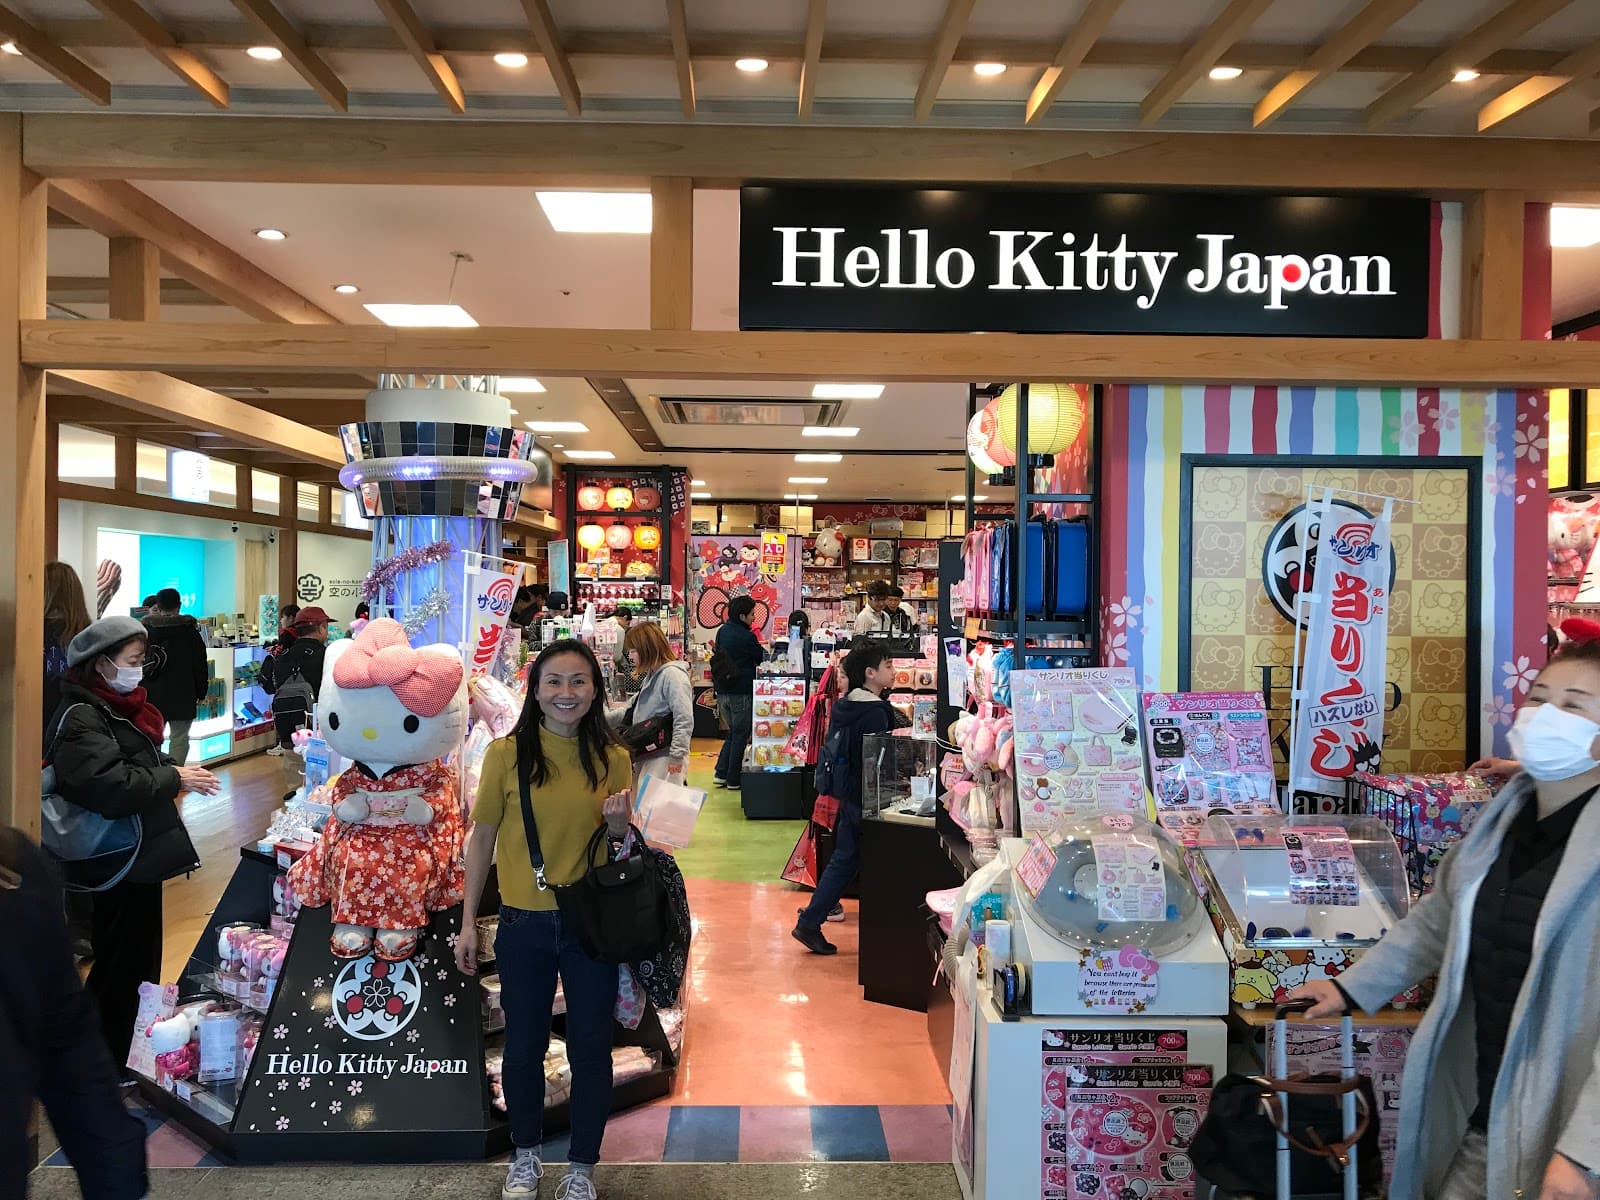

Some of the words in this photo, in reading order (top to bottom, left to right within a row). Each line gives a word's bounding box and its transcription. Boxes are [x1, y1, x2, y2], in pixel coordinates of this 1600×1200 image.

[772, 227, 975, 289] Hello
[989, 230, 1178, 309] Kitty
[1186, 233, 1396, 310] Japan
[765, 544, 783, 553] 入口
[1040, 671, 1108, 681] サンリオ当りくじ
[1177, 699, 1257, 709] サンリオ当りくじ
[1314, 700, 1374, 724] ハズレなし
[1087, 968, 1101, 977] You
[1070, 1032, 1156, 1043] サンリオ当りくじ
[264, 1053, 333, 1075] Hello
[335, 1053, 398, 1080] Kitty
[400, 1053, 469, 1080] Japan
[1095, 1069, 1181, 1080] サンリオ当りくじ
